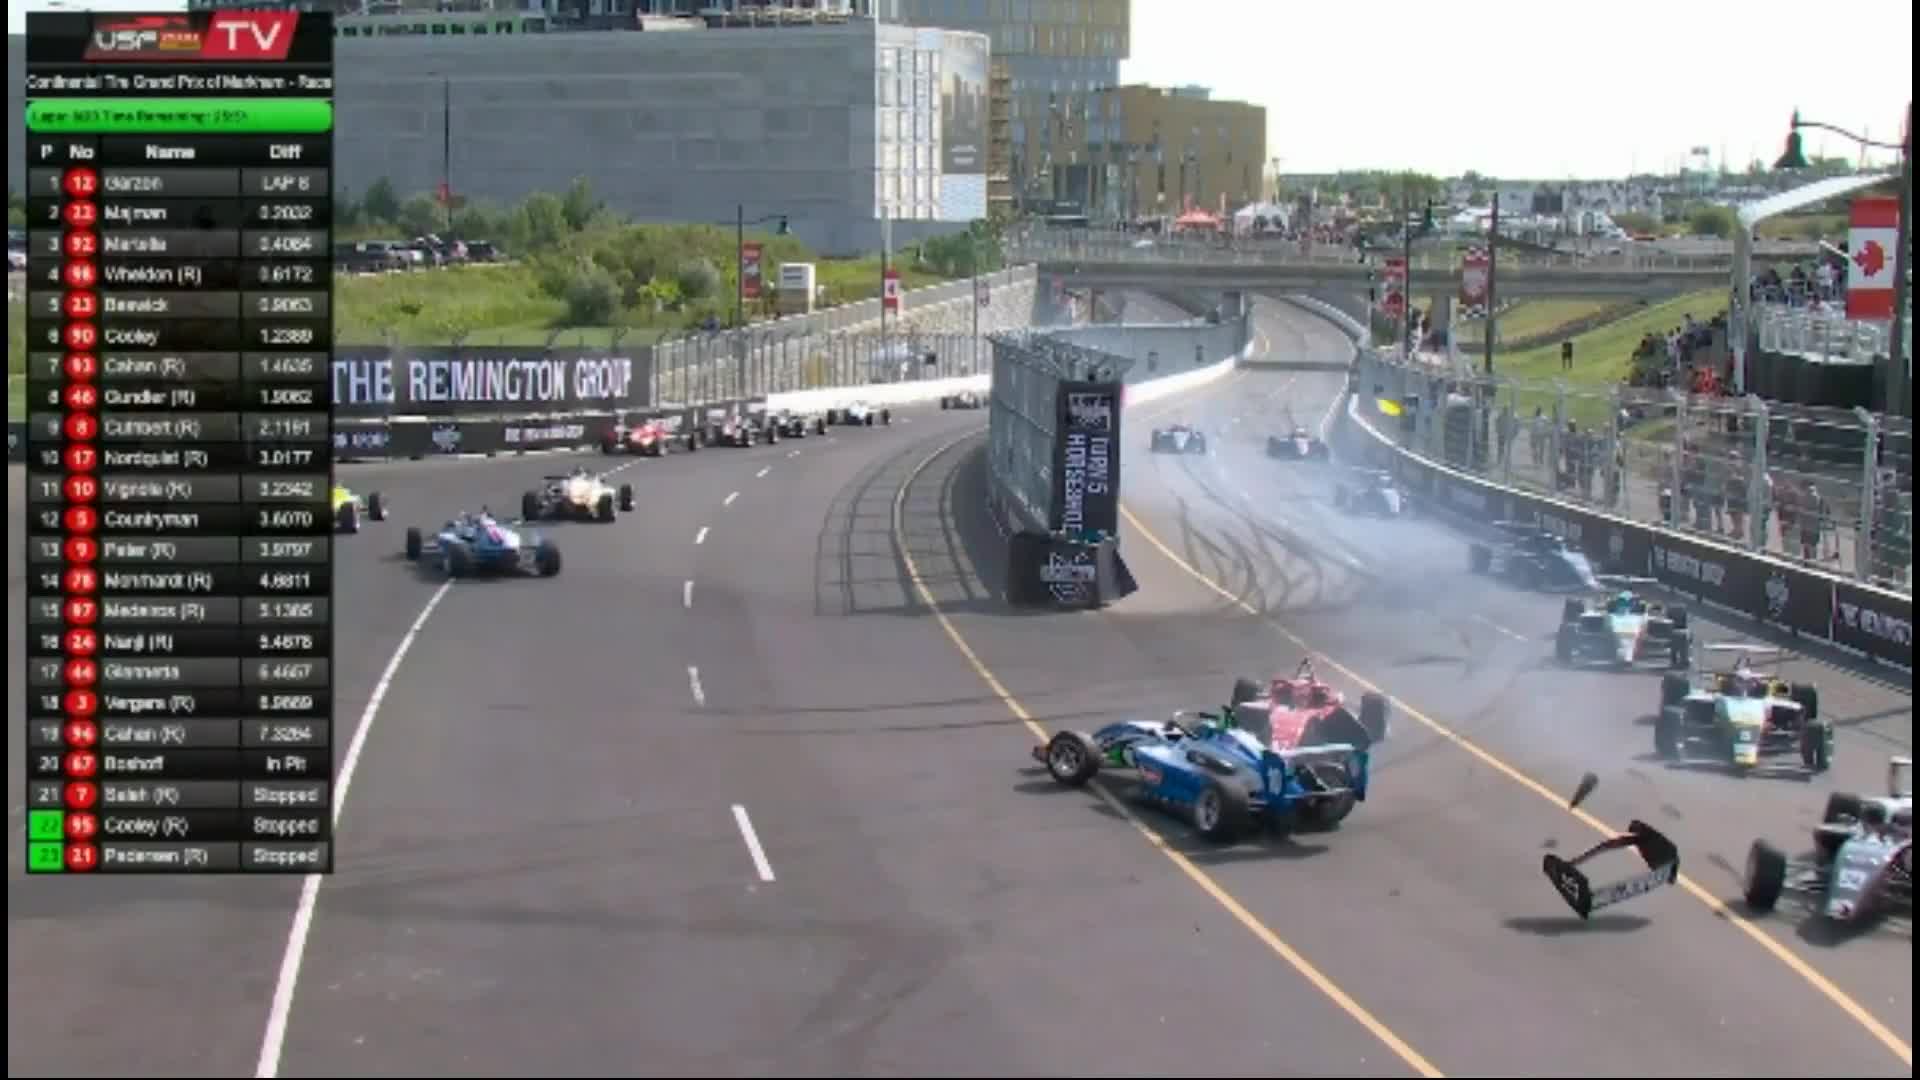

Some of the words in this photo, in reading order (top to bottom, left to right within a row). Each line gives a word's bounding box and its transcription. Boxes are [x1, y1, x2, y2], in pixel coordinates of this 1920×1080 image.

[333, 360, 395, 404] THE
[407, 359, 565, 401] REMINGTON
[575, 357, 632, 398] GROUP
